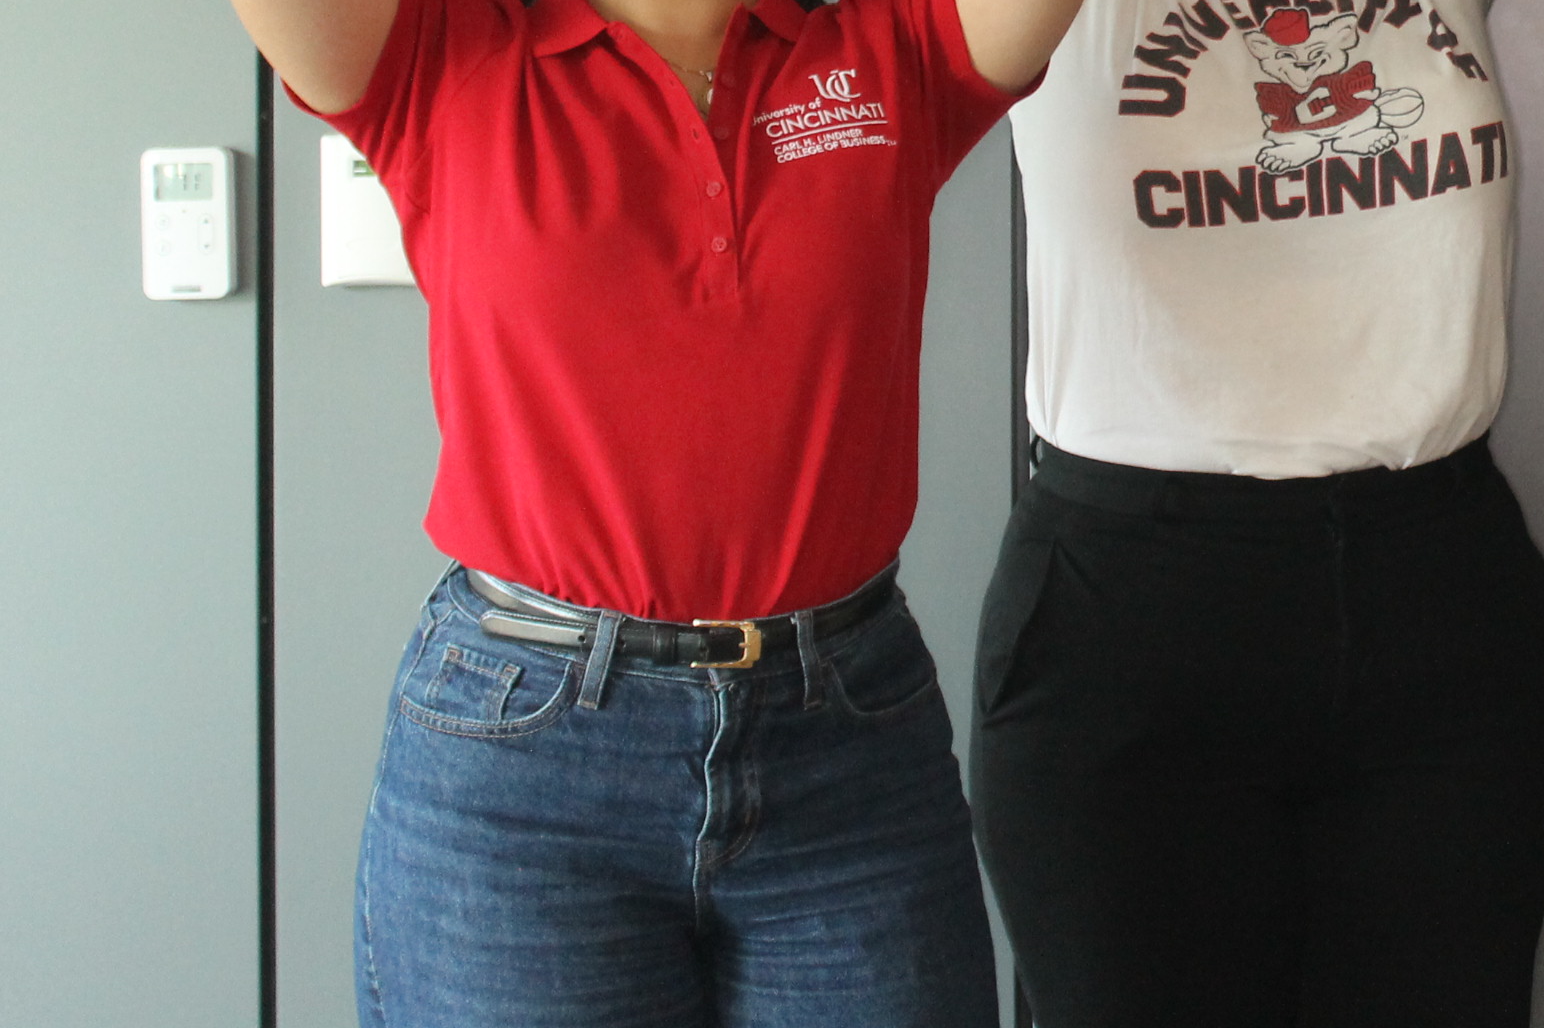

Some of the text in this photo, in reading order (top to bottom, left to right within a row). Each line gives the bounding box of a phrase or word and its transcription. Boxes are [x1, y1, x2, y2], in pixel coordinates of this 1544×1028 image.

[1427, 9, 1488, 82] OF
[808, 68, 862, 103] UC
[765, 102, 886, 138] CINCINNATI
[808, 97, 822, 110] of
[773, 140, 803, 156] CARL
[817, 128, 864, 143] LINDNER
[777, 144, 824, 164] COLLEGE
[824, 140, 839, 151] OF
[840, 135, 885, 149] BUSINESS
[1132, 120, 1509, 229] CINCINNATI
